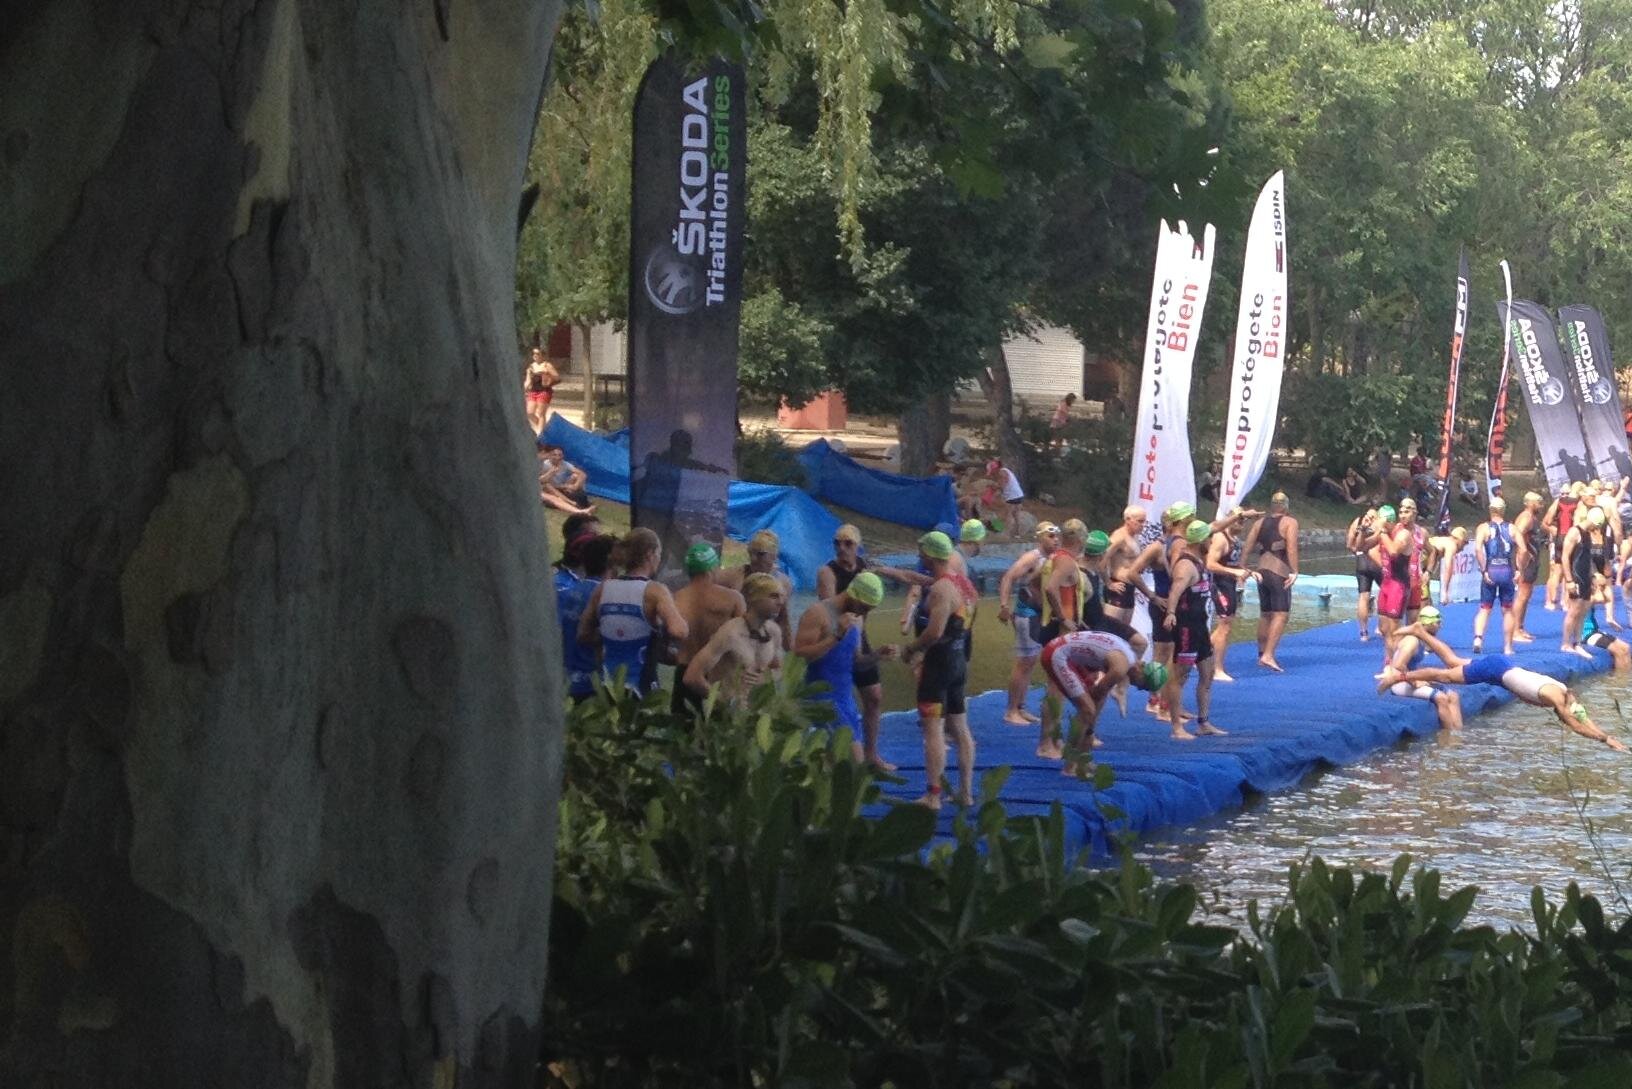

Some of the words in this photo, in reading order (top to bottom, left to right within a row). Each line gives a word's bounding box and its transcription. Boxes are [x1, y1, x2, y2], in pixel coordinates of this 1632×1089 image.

[671, 76, 708, 256] ŠKODA
[1272, 190, 1283, 237] ISDIN
[1166, 283, 1199, 352] Bien
[1263, 295, 1282, 359] Bien
